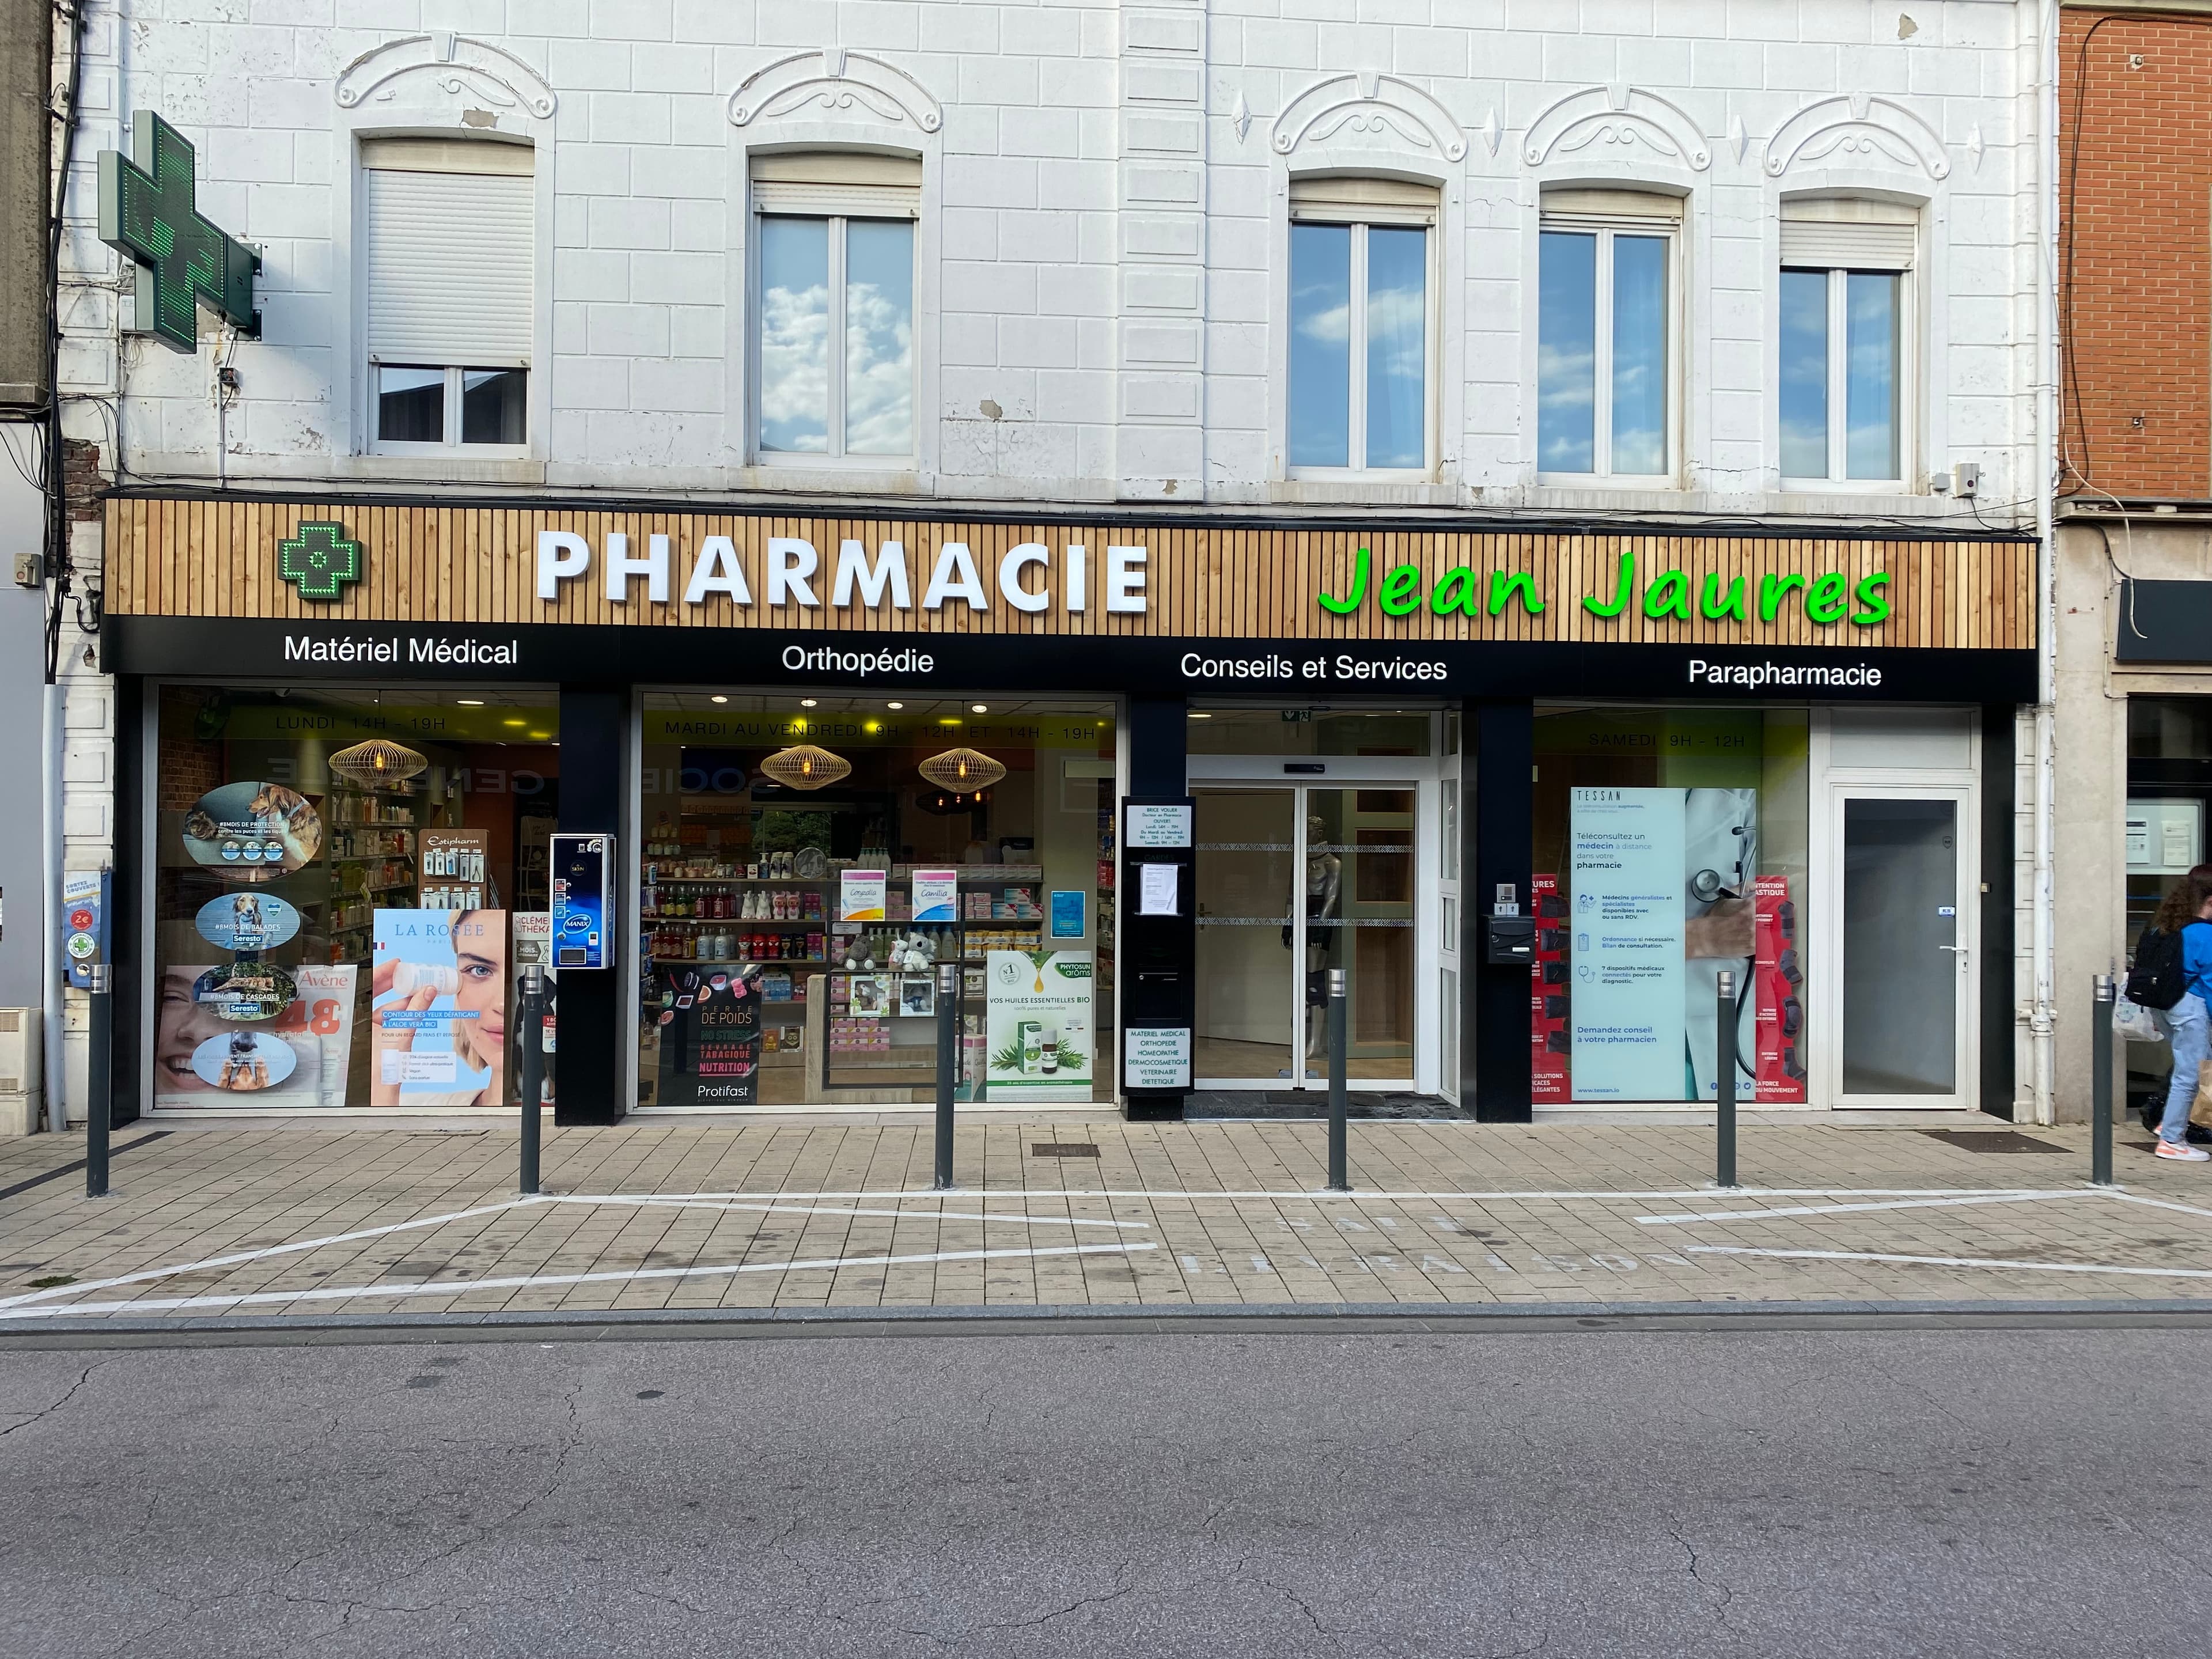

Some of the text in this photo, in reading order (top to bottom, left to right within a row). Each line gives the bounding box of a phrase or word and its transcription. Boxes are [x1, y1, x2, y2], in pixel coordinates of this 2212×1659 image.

[537, 530, 1147, 614] PHARMACIE
[1317, 548, 1891, 624] Jean Jaures
[284, 635, 518, 665] Matériel Médical
[782, 645, 935, 677] Orthopédie
[1180, 653, 1448, 681] Conseils et Services
[1688, 659, 1882, 687] Parapharmacie
[275, 716, 445, 730] LUNDI 14H 19H
[665, 722, 1096, 740] MARDI AU VENDREDI 9H 12H ET 14H 19H
[1589, 733, 1745, 748] SAMEDI 9H 12H
[1577, 790, 1621, 802] TESSAN
[426, 836, 479, 846] Estipharm
[1577, 832, 1633, 840] Téléconsultez
[1577, 861, 1622, 871] pharmacie
[1532, 880, 1555, 888] URES
[75, 915, 88, 923] 2€
[521, 915, 550, 925] CLÉME
[395, 923, 484, 936] LA ROSÉE
[233, 934, 262, 942] Seresto
[298, 971, 349, 987] Avène
[701, 1012, 752, 1024] DE POIDS
[700, 1031, 713, 1040] NO
[1577, 1026, 1653, 1034] Demandez conseil
[1608, 1035, 1657, 1044] pharmacien
[700, 1050, 751, 1059] TABAGIQUE
[699, 1062, 750, 1072] NUTRITION
[698, 1085, 749, 1097] Protifast
